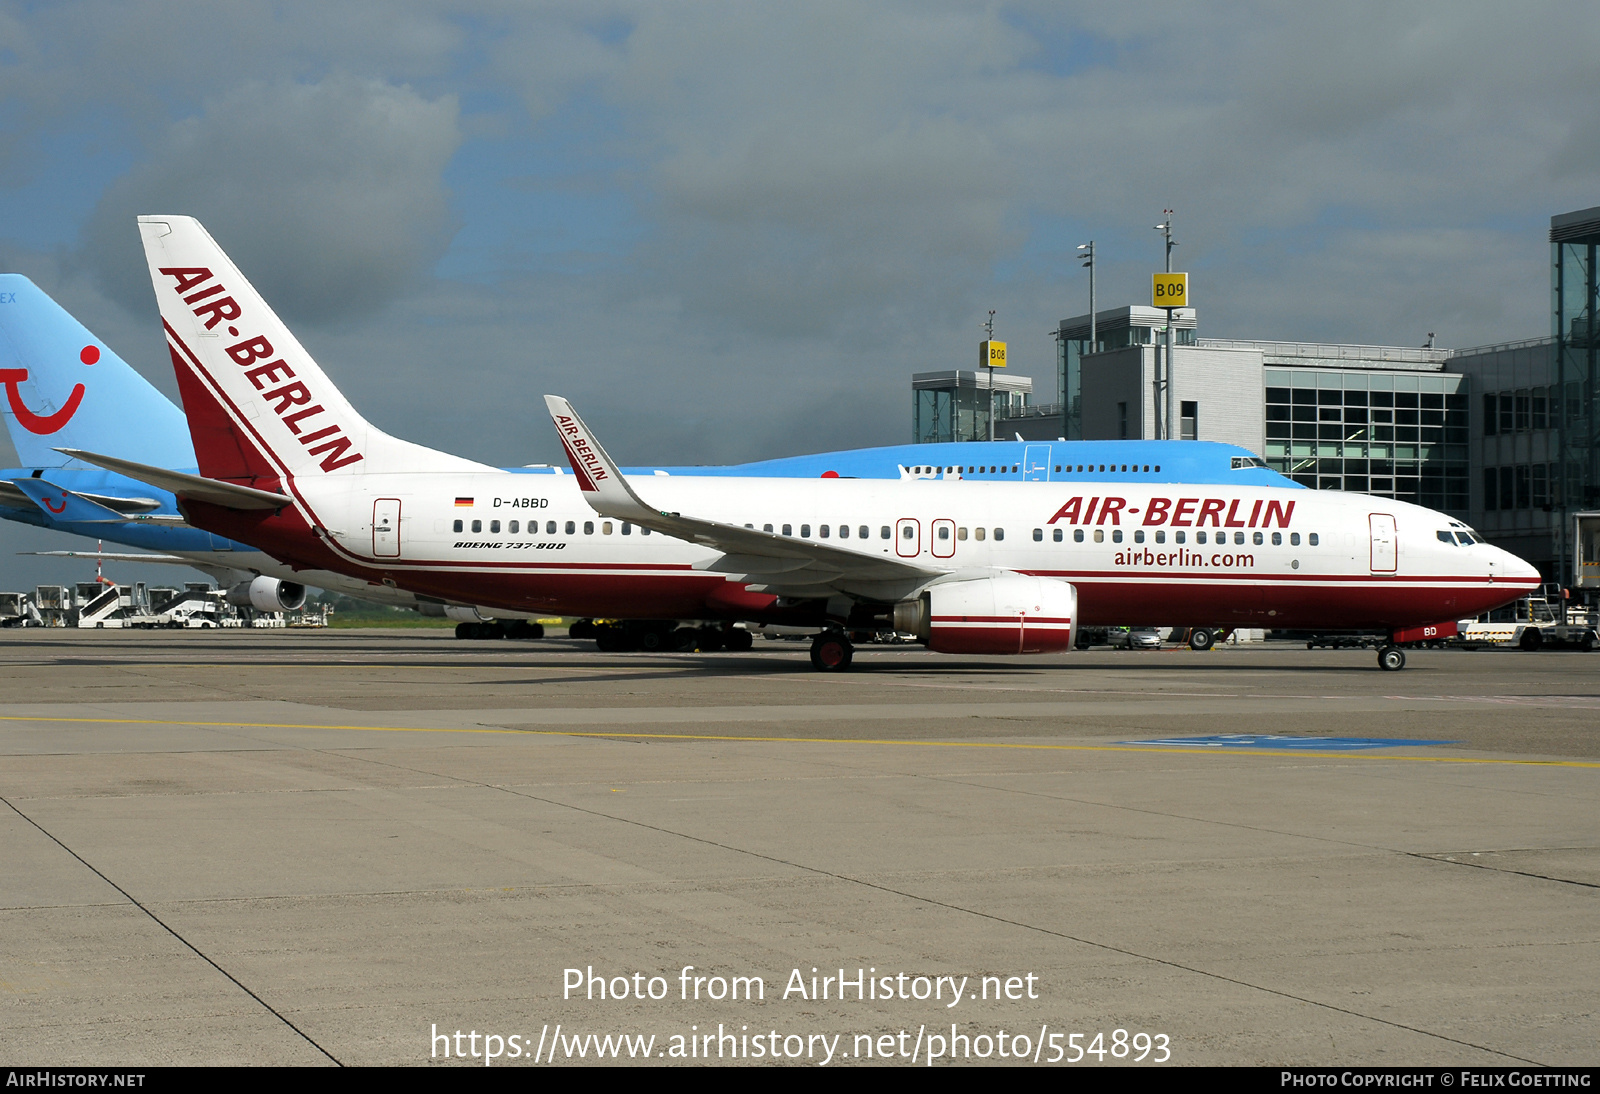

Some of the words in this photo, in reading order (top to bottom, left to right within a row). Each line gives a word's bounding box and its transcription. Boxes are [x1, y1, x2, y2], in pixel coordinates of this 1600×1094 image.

[1156, 283, 1165, 297] B
[1167, 283, 1184, 297] 09
[158, 267, 364, 473] AIR-BERLIN
[555, 414, 609, 481] AIR-BERLIN
[493, 497, 549, 509] D-ABBD
[1046, 496, 1296, 529] AIR-BERLIN
[453, 541, 503, 549] BOEING
[505, 542, 567, 550] 737-800
[1114, 547, 1255, 568] airberlin.com
[1423, 626, 1437, 636] BD
